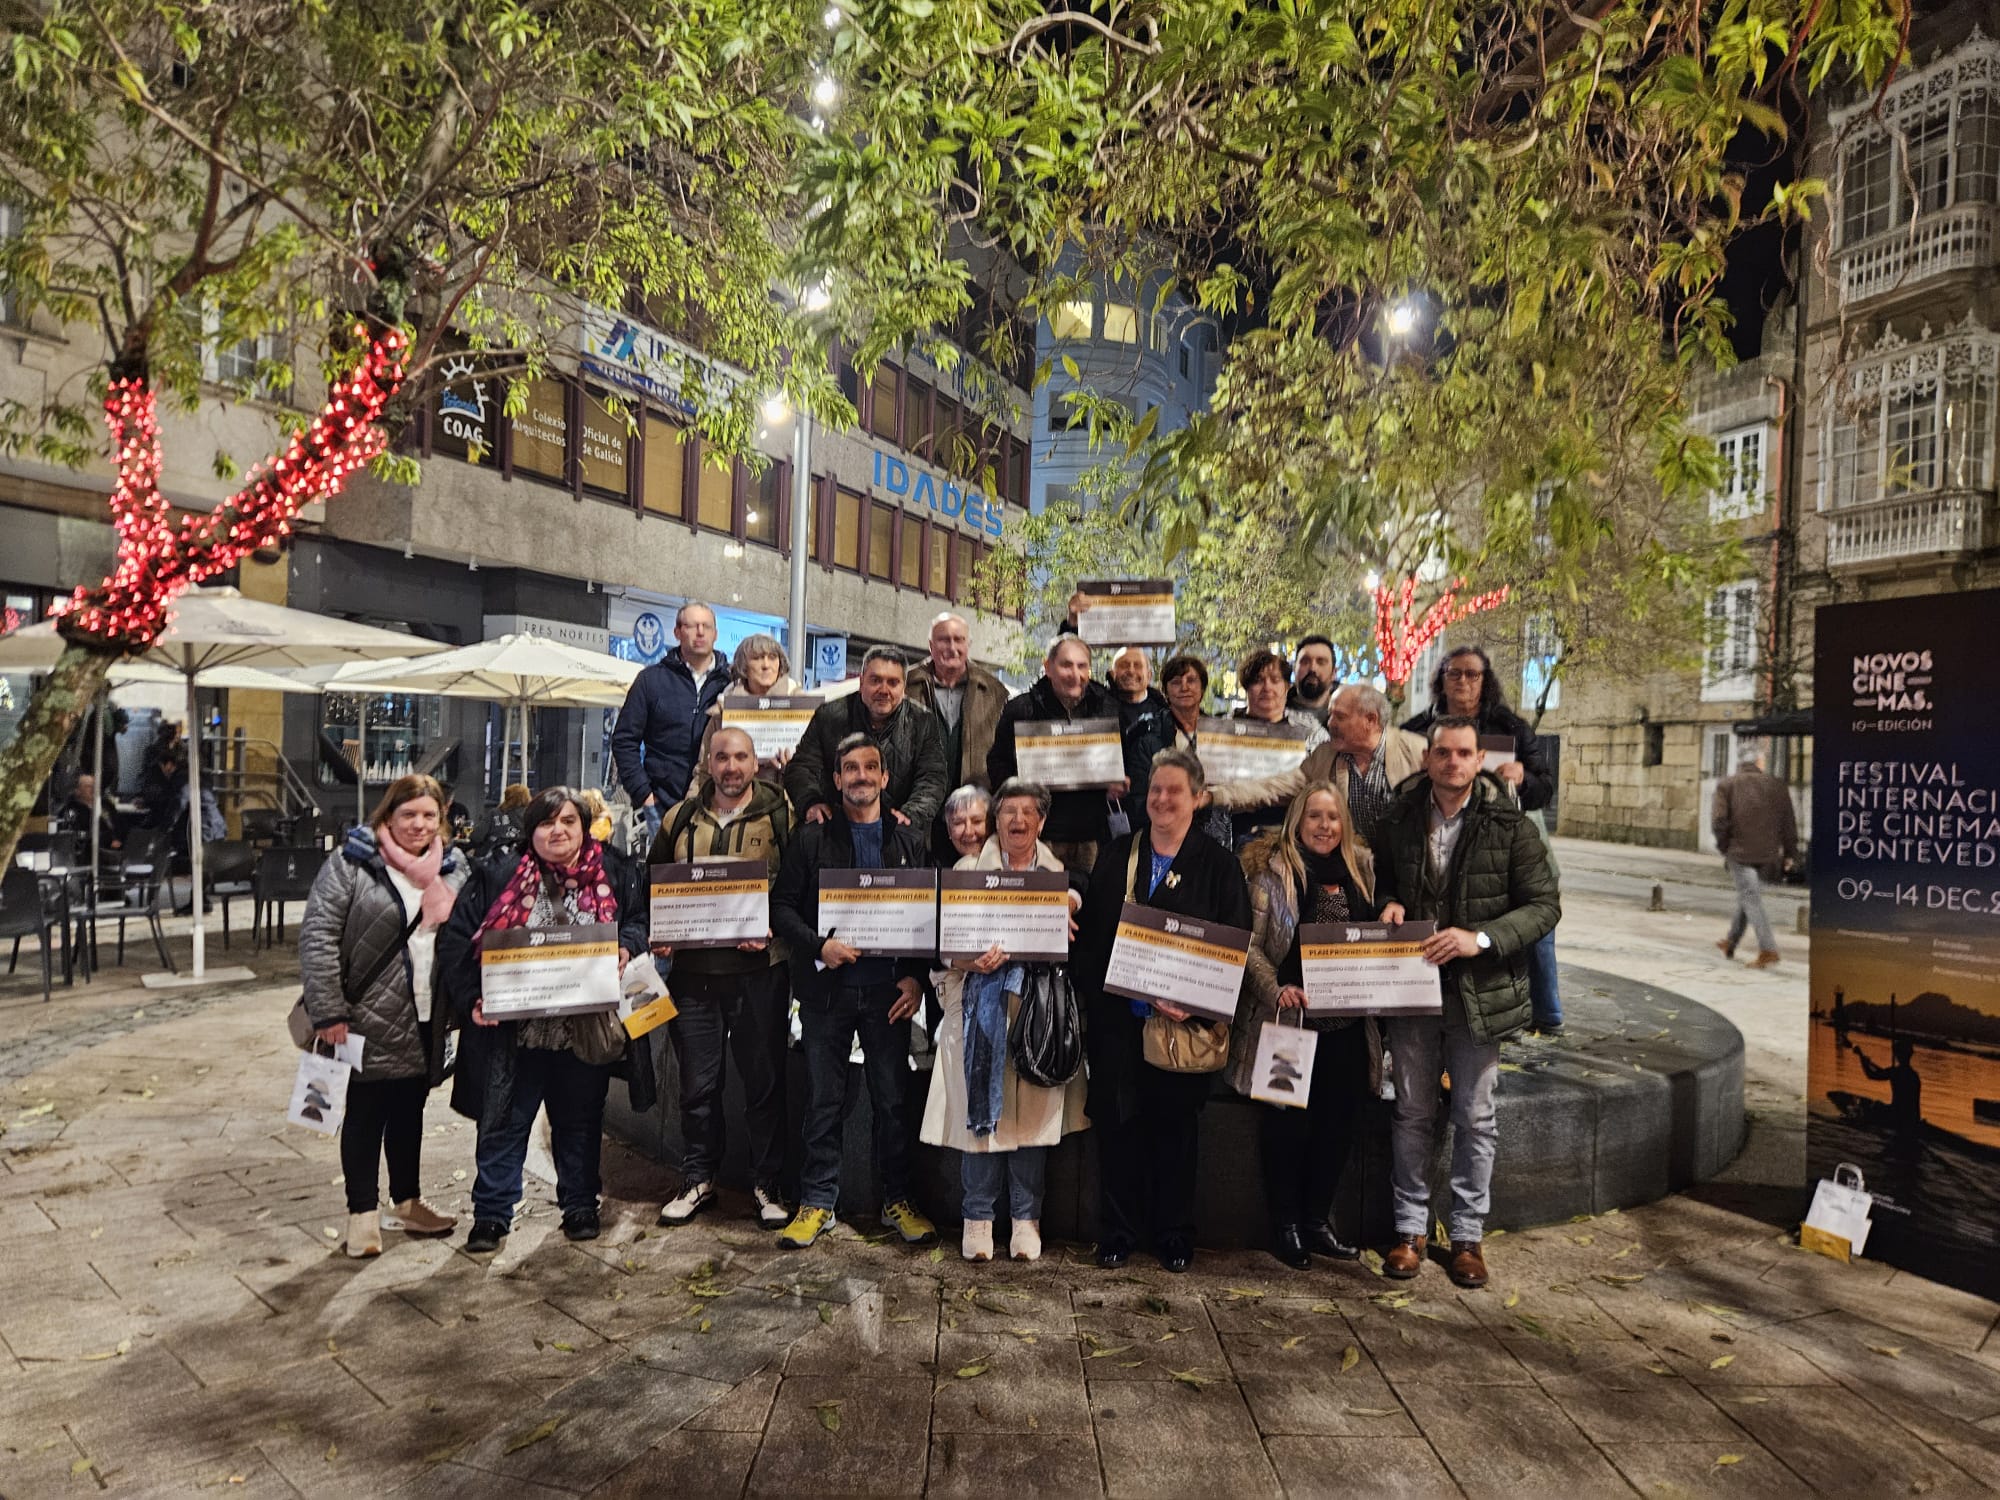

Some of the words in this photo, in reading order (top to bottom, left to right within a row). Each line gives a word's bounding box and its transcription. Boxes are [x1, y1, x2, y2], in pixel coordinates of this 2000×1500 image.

[443, 417, 483, 444] COAG
[532, 408, 566, 431] Colexio
[611, 436, 622, 450] de
[512, 420, 566, 447] Arquitectos
[594, 447, 623, 466] Galicia
[524, 621, 552, 638] TRES
[1853, 649, 1933, 674] NOVOS
[1838, 761, 1965, 787] FESTIVAL
[1838, 786, 1996, 814] INTERNACI
[1838, 810, 1873, 835] DE
[1883, 812, 2000, 840] CINEMA
[1838, 835, 2000, 867] PONTEVED
[658, 887, 674, 895] PLAN
